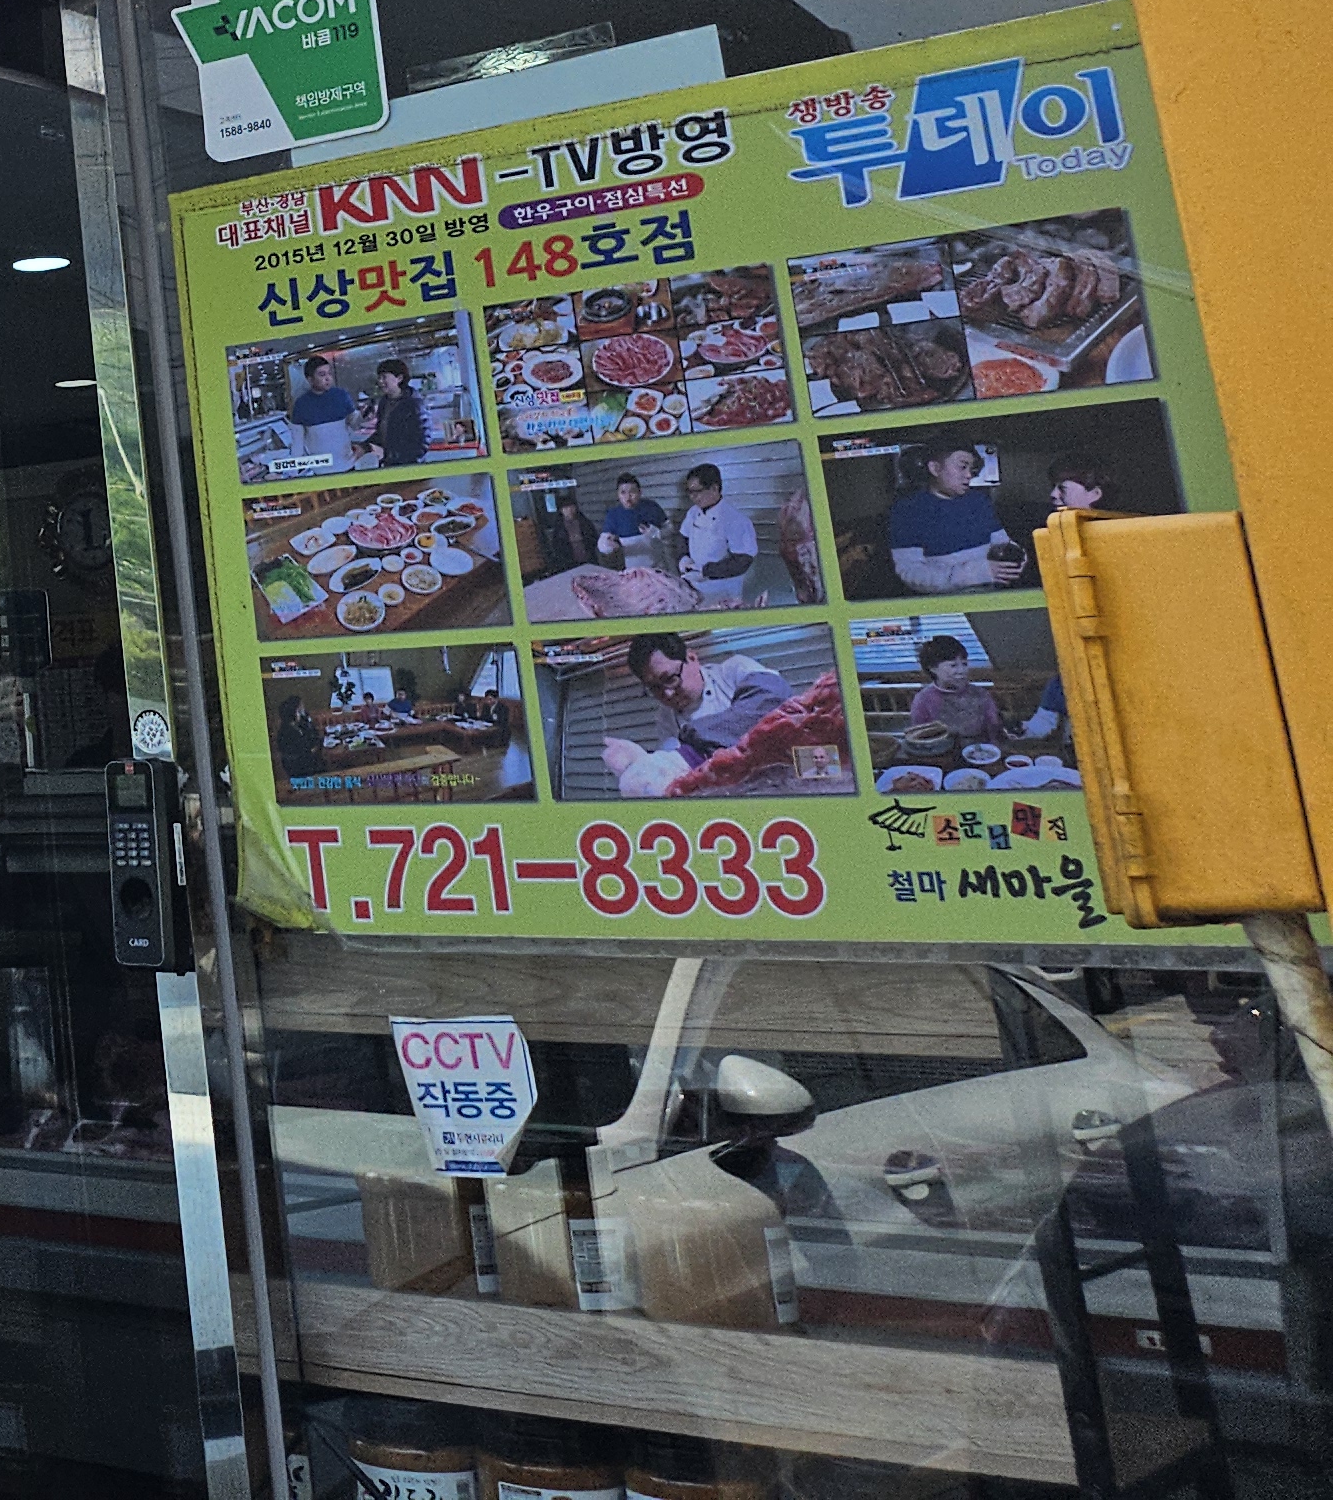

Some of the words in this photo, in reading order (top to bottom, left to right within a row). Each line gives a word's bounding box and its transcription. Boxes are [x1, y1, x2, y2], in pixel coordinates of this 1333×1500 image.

[294, 80, 367, 108] 책임방제구역
[787, 83, 895, 124] 생방송
[219, 117, 273, 139] 1588-9840
[788, 64, 1126, 208] 투데이
[1016, 142, 1133, 181] Today
[321, 155, 486, 234] KNN
[217, 208, 312, 250] 대표채널
[254, 238, 328, 271] 2015년
[332, 229, 380, 258] 12월
[385, 221, 437, 249] 30일
[444, 211, 491, 239] 방영
[256, 249, 459, 328] 신상맛집
[473, 209, 697, 291] 148호점
[285, 819, 830, 925] T.721-8333
[886, 869, 947, 903] 철마
[958, 853, 1109, 930] 새마을
[128, 937, 150, 948] CARD
[401, 1031, 516, 1071] CCTV
[416, 1080, 518, 1120] 작동중
